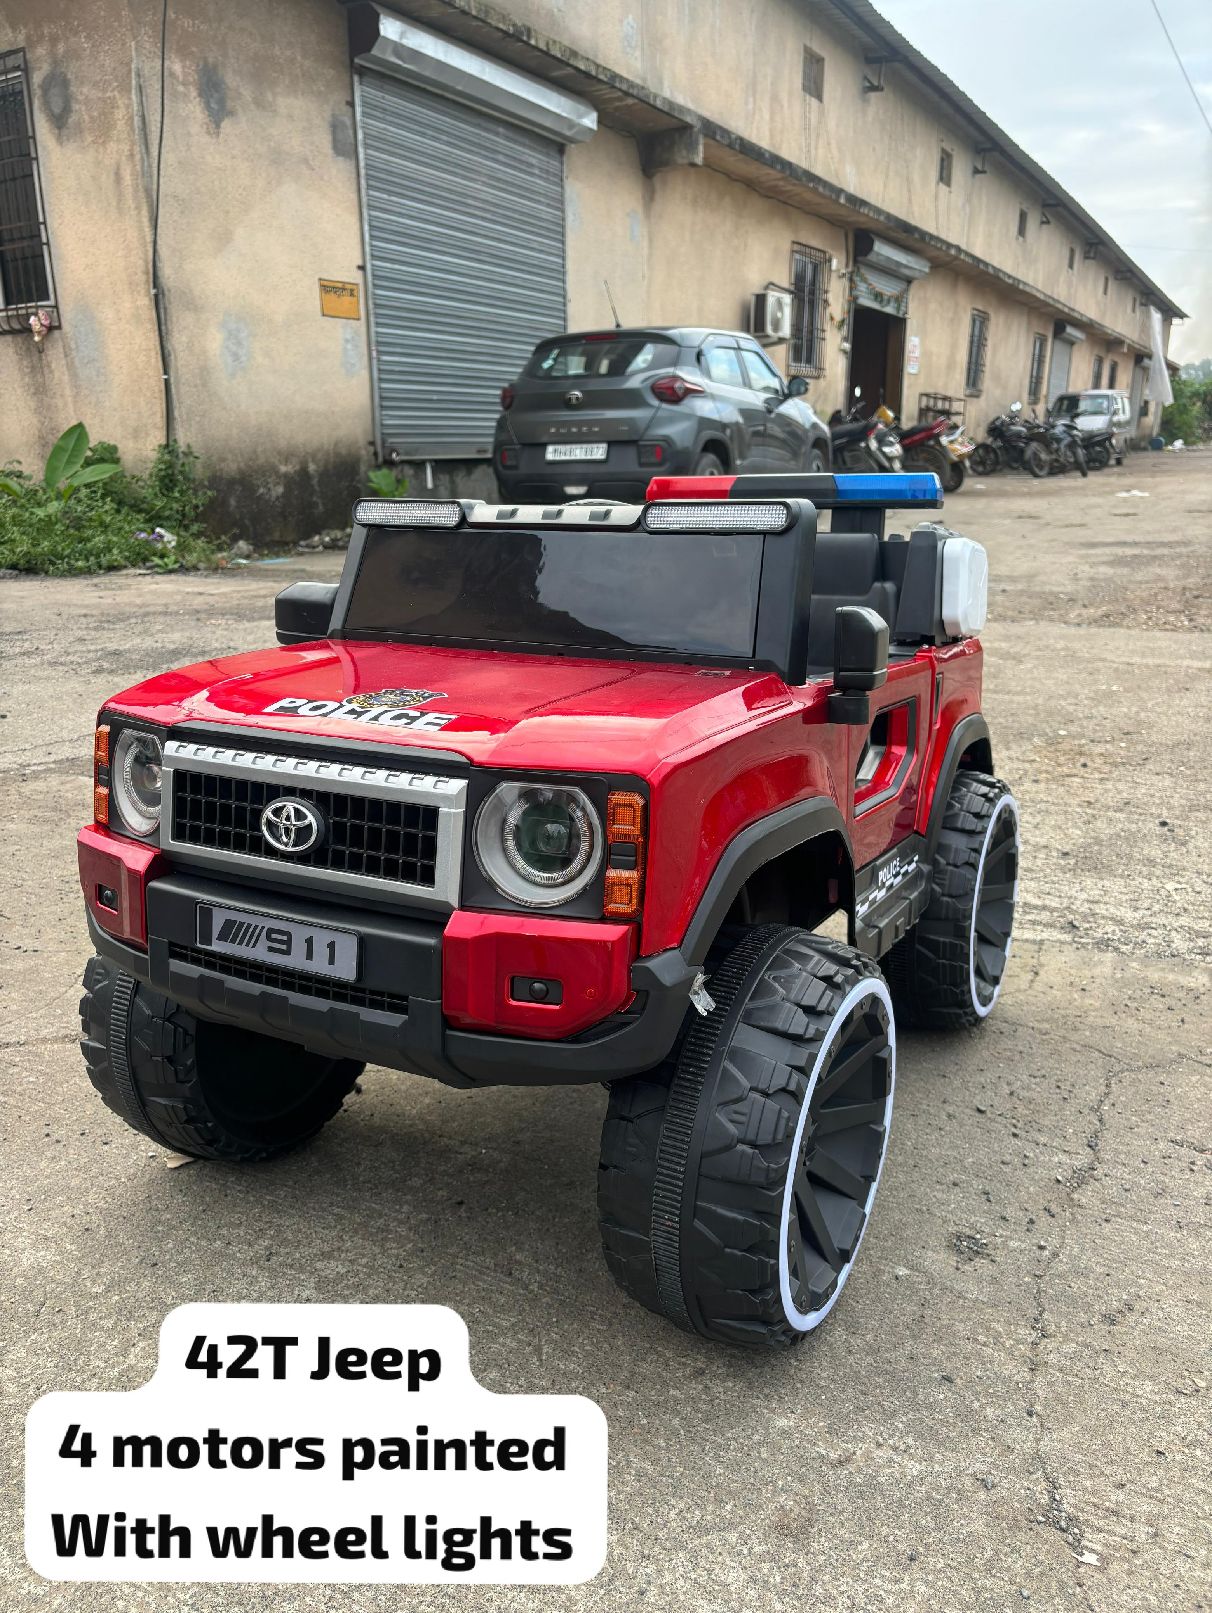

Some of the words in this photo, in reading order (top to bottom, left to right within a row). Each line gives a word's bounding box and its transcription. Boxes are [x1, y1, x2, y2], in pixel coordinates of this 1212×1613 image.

[261, 697, 460, 732] POLICE
[878, 857, 900, 887] POLICE
[265, 927, 337, 966] 911
